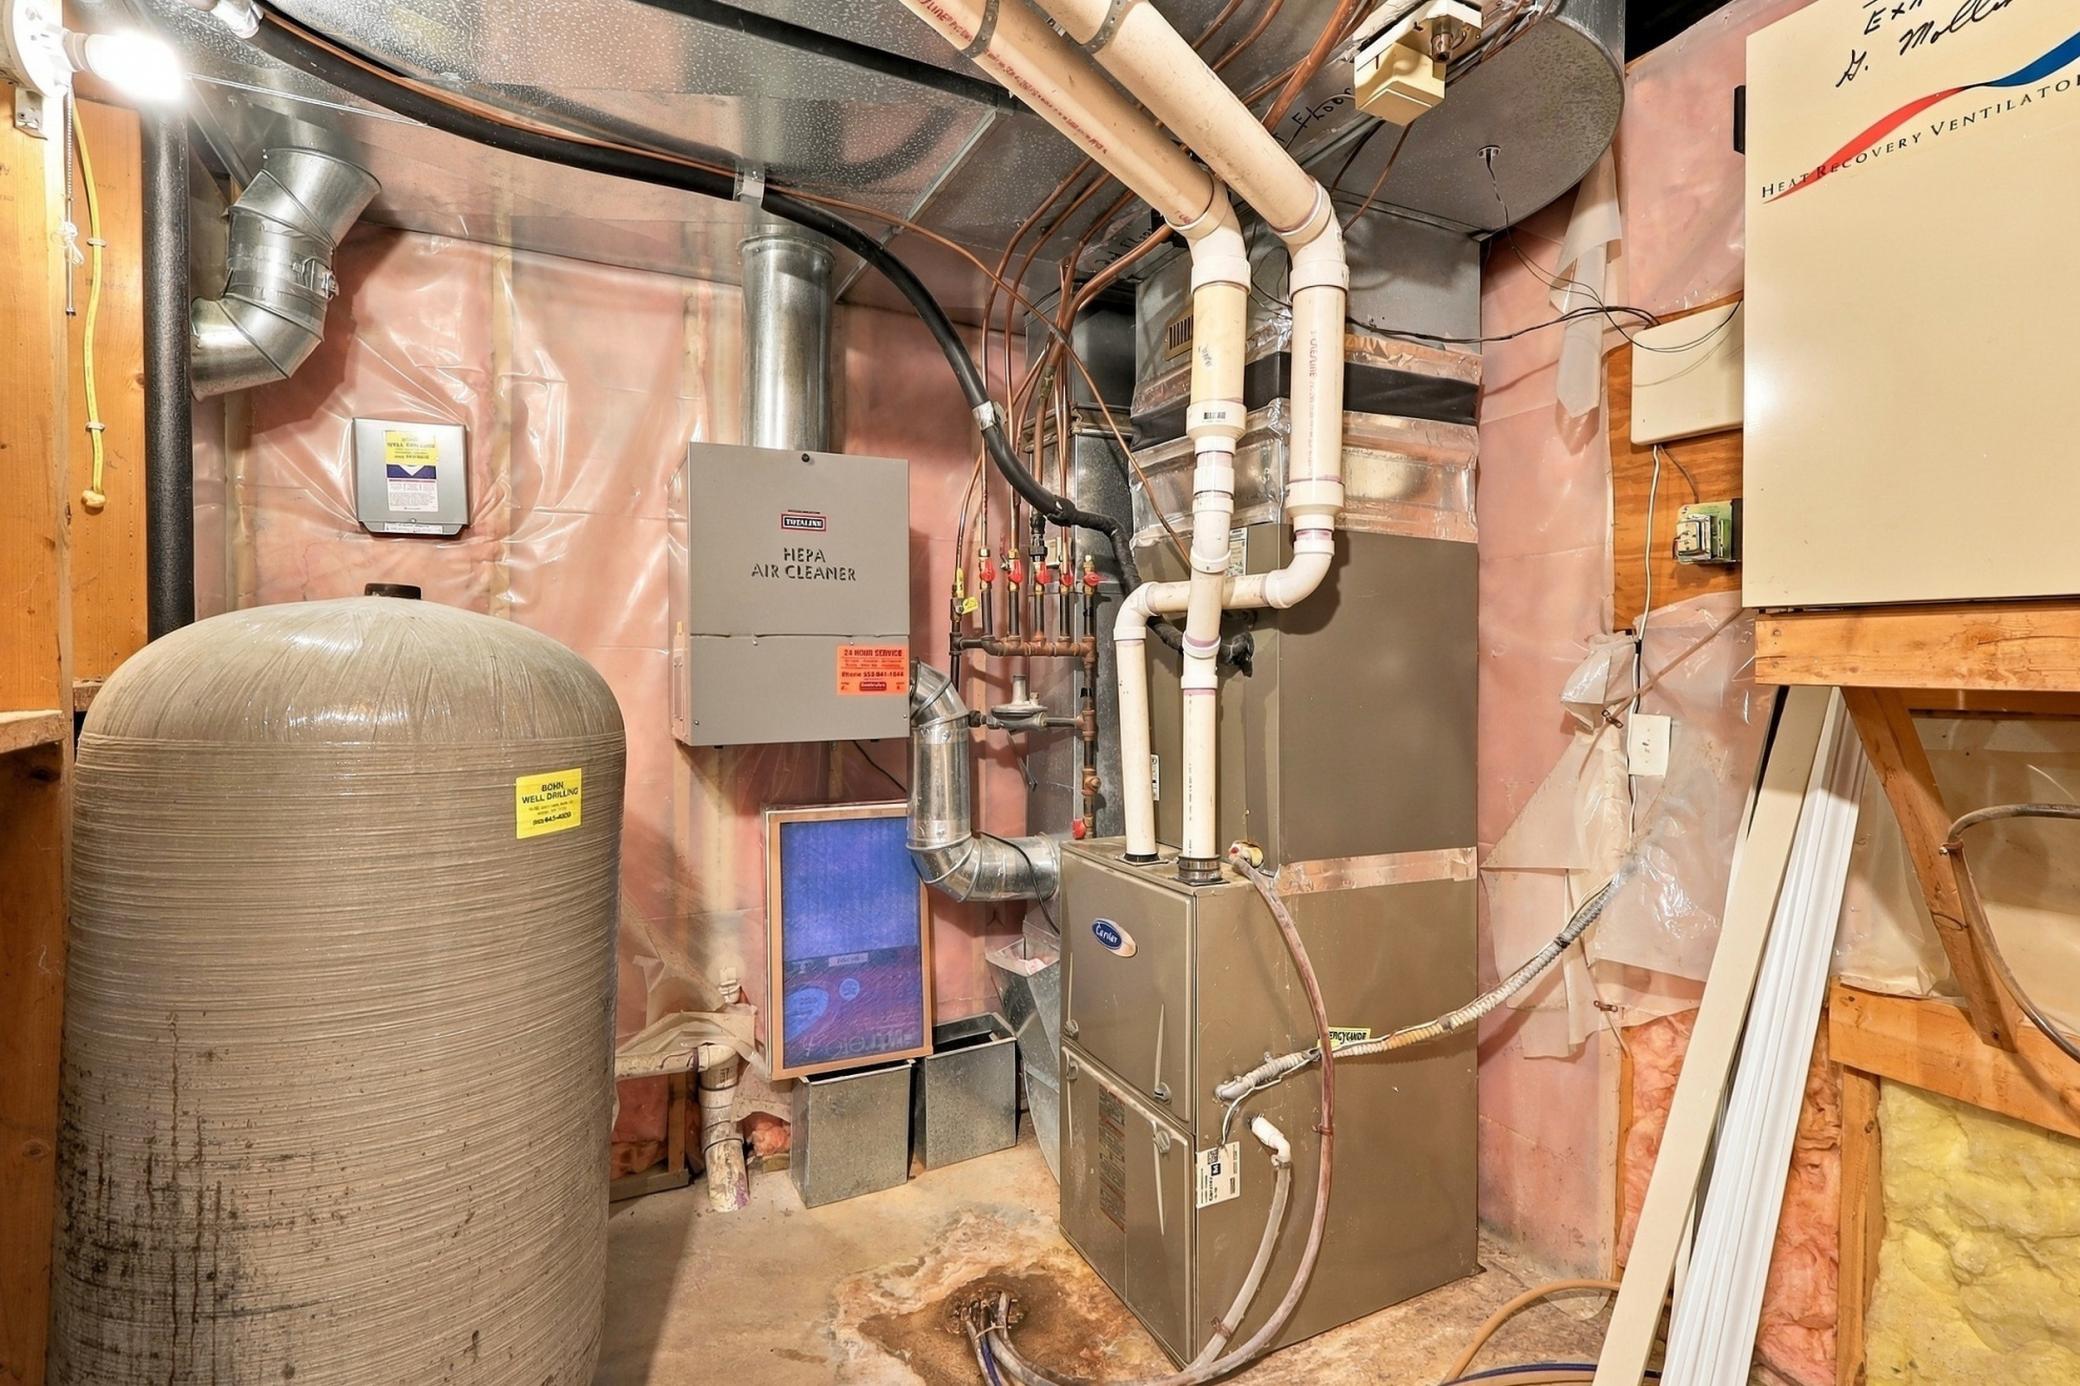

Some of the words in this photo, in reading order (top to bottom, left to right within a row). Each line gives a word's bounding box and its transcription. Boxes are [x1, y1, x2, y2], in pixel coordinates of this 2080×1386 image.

[1761, 171, 1810, 198] HEAT
[1816, 131, 1922, 180] RECOVERY
[783, 547, 826, 563] HEPA
[751, 563, 780, 579] AIR
[784, 564, 856, 581] CLEANER
[874, 649, 902, 657] SERVICE
[541, 781, 564, 792] BOHN
[522, 795, 545, 804] WELL
[546, 787, 579, 800] DRILLING
